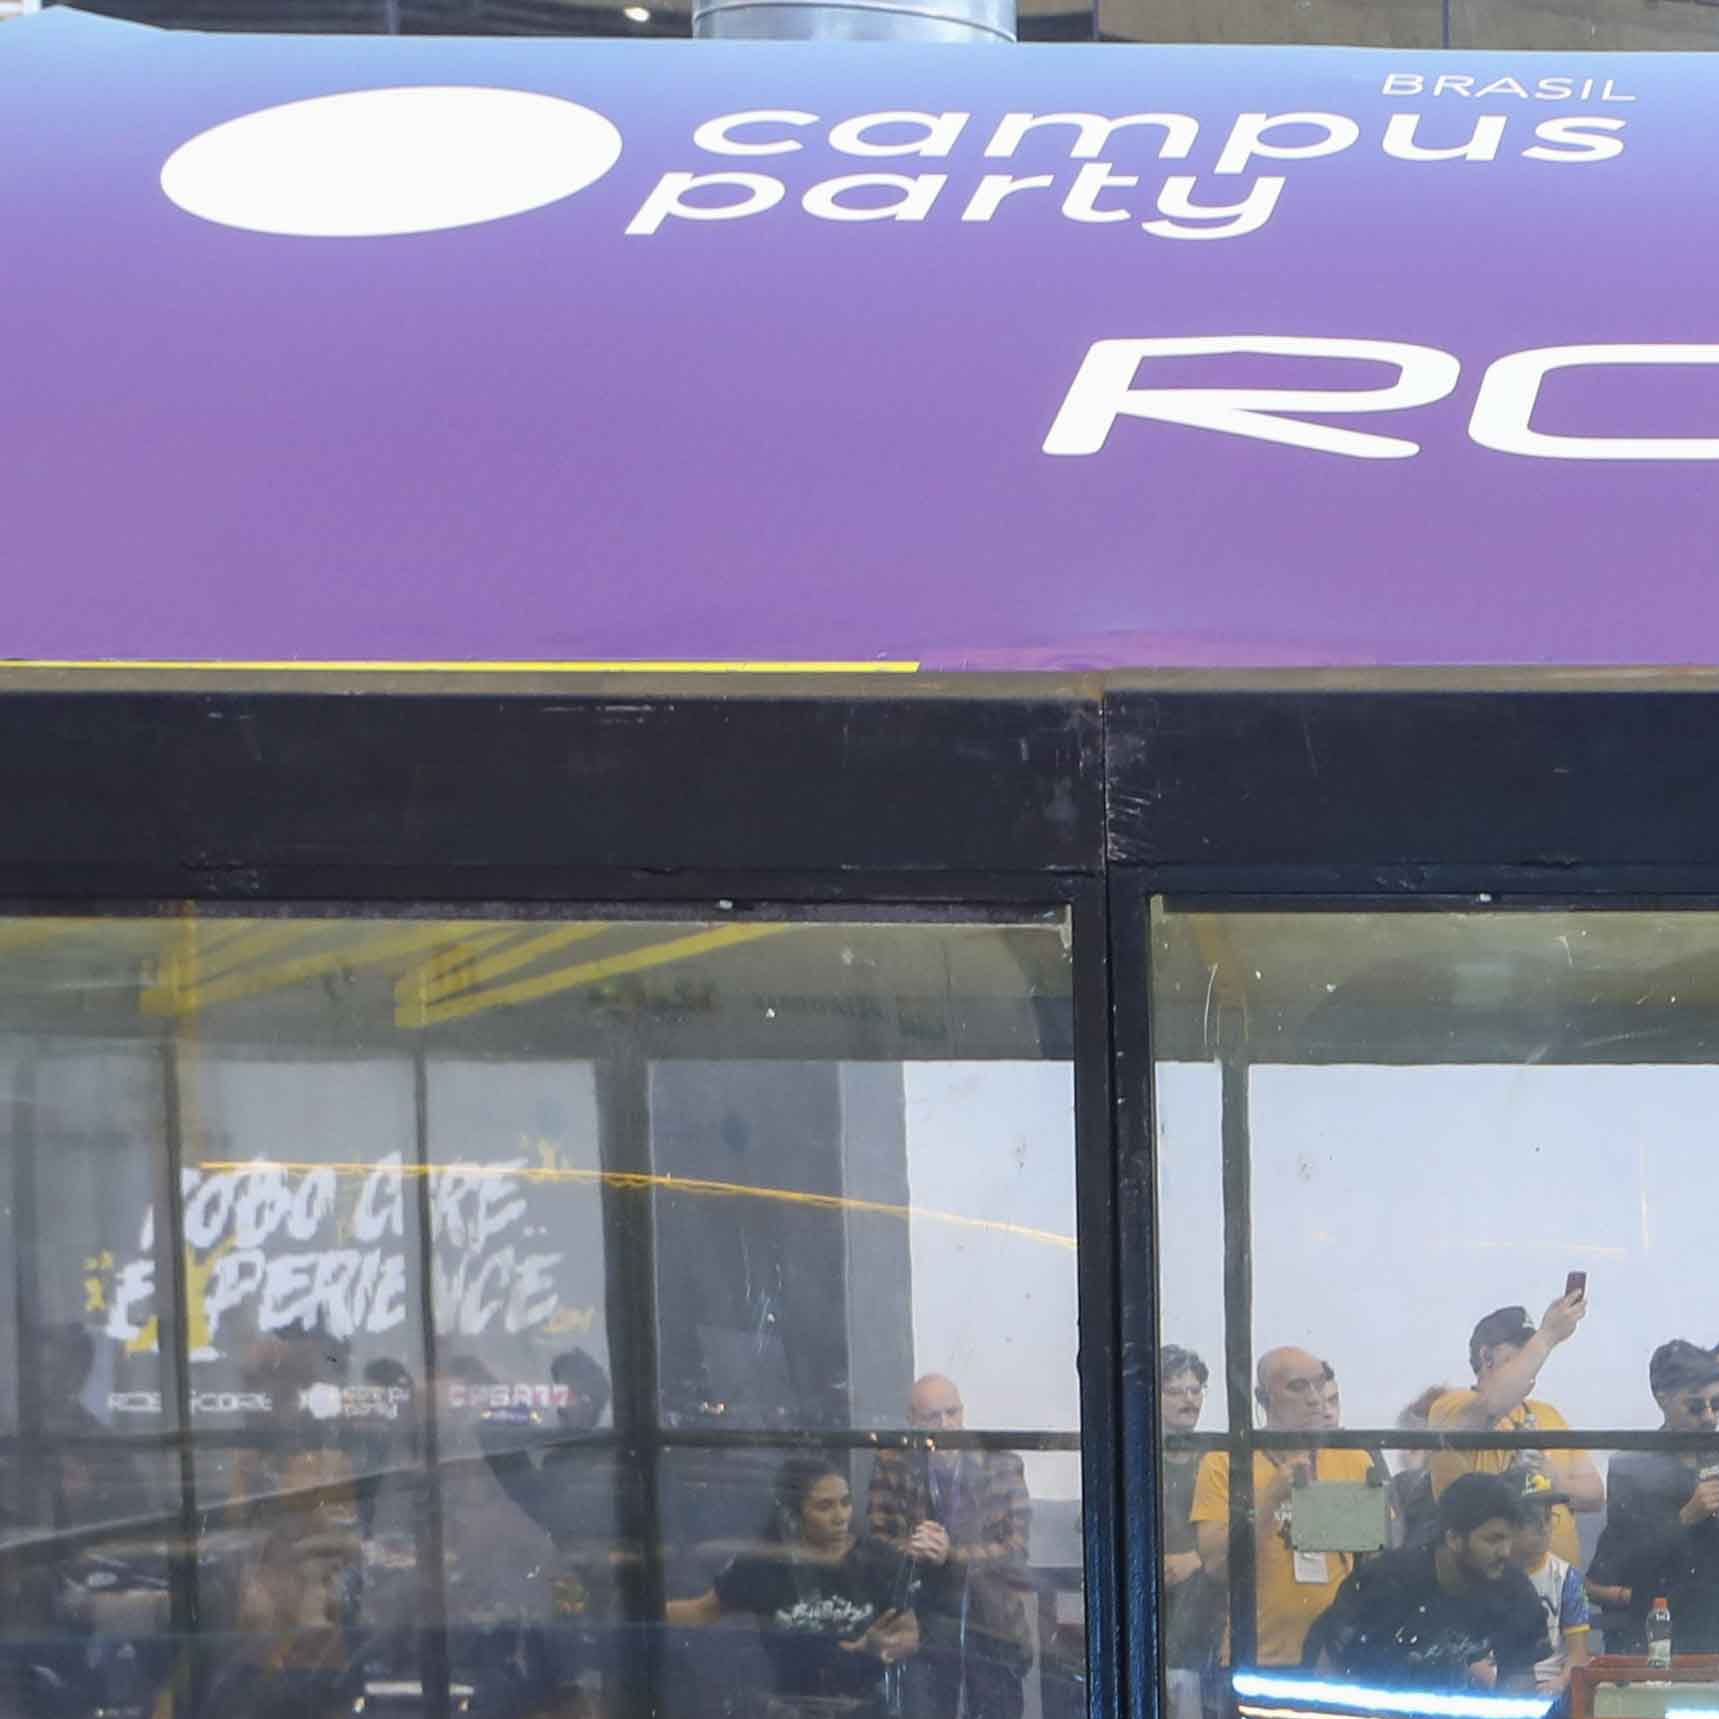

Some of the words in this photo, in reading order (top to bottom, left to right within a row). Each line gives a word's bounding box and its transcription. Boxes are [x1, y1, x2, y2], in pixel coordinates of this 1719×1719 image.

[1381, 73, 1637, 101] BRASIL
[693, 110, 1627, 173] campus
[624, 163, 1287, 240] party
